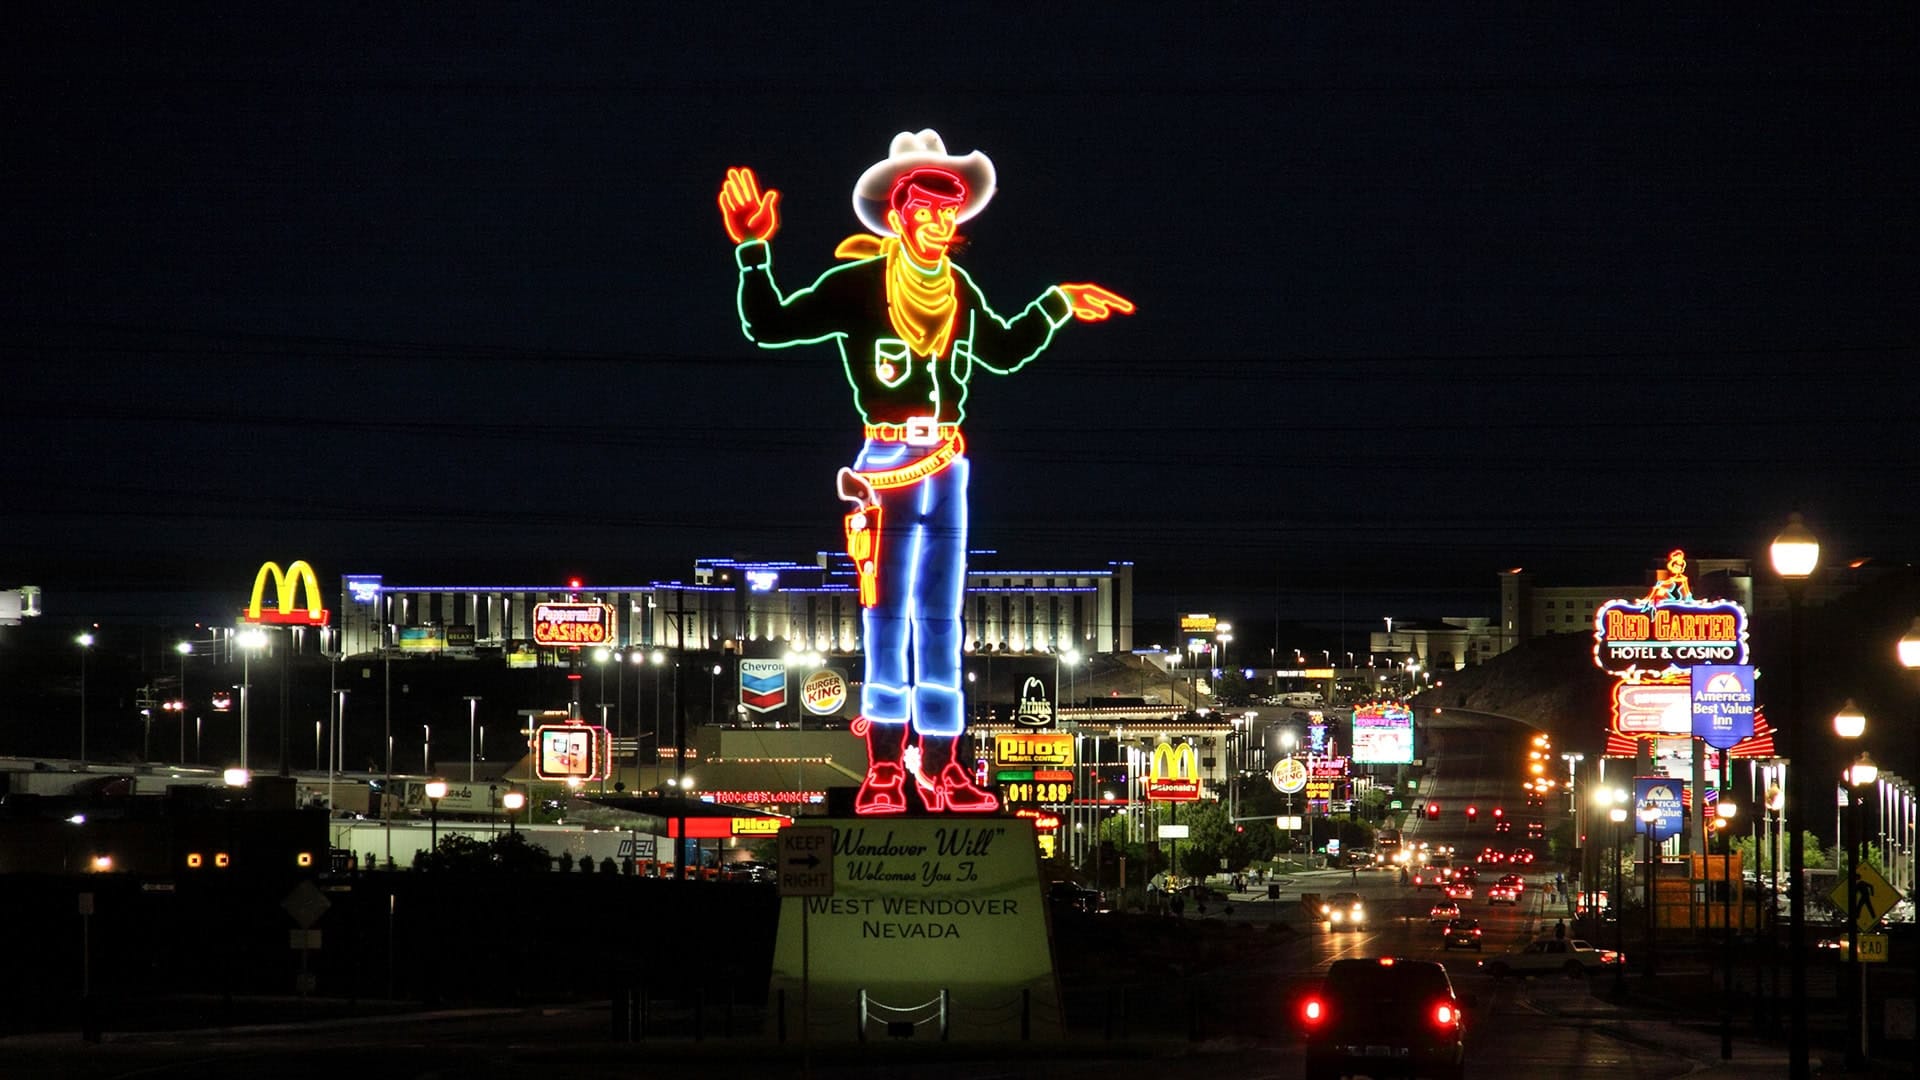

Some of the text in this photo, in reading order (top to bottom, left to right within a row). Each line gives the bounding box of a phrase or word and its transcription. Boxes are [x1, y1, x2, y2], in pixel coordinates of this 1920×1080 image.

[537, 623, 603, 641] CASINO
[1607, 610, 1736, 640] RED GARTER
[1611, 647, 1734, 659] HOTEL & CASINO
[742, 662, 785, 671] Chevron
[806, 677, 840, 693] BURGER
[808, 685, 841, 703] KING
[1695, 690, 1751, 701] Americas
[1018, 697, 1052, 714] Arby's
[1693, 702, 1753, 714] Best Value
[1713, 715, 1732, 725] Inn
[1000, 739, 1070, 760] Pilot
[732, 818, 781, 834] Pilot
[785, 837, 825, 850] KEEP
[784, 874, 828, 888] RIGHT
[847, 862, 978, 888] Welcomes You To
[809, 896, 1018, 915] WEST WENDOVER
[863, 921, 960, 938] NEVADA
[1861, 941, 1882, 954] EAD
